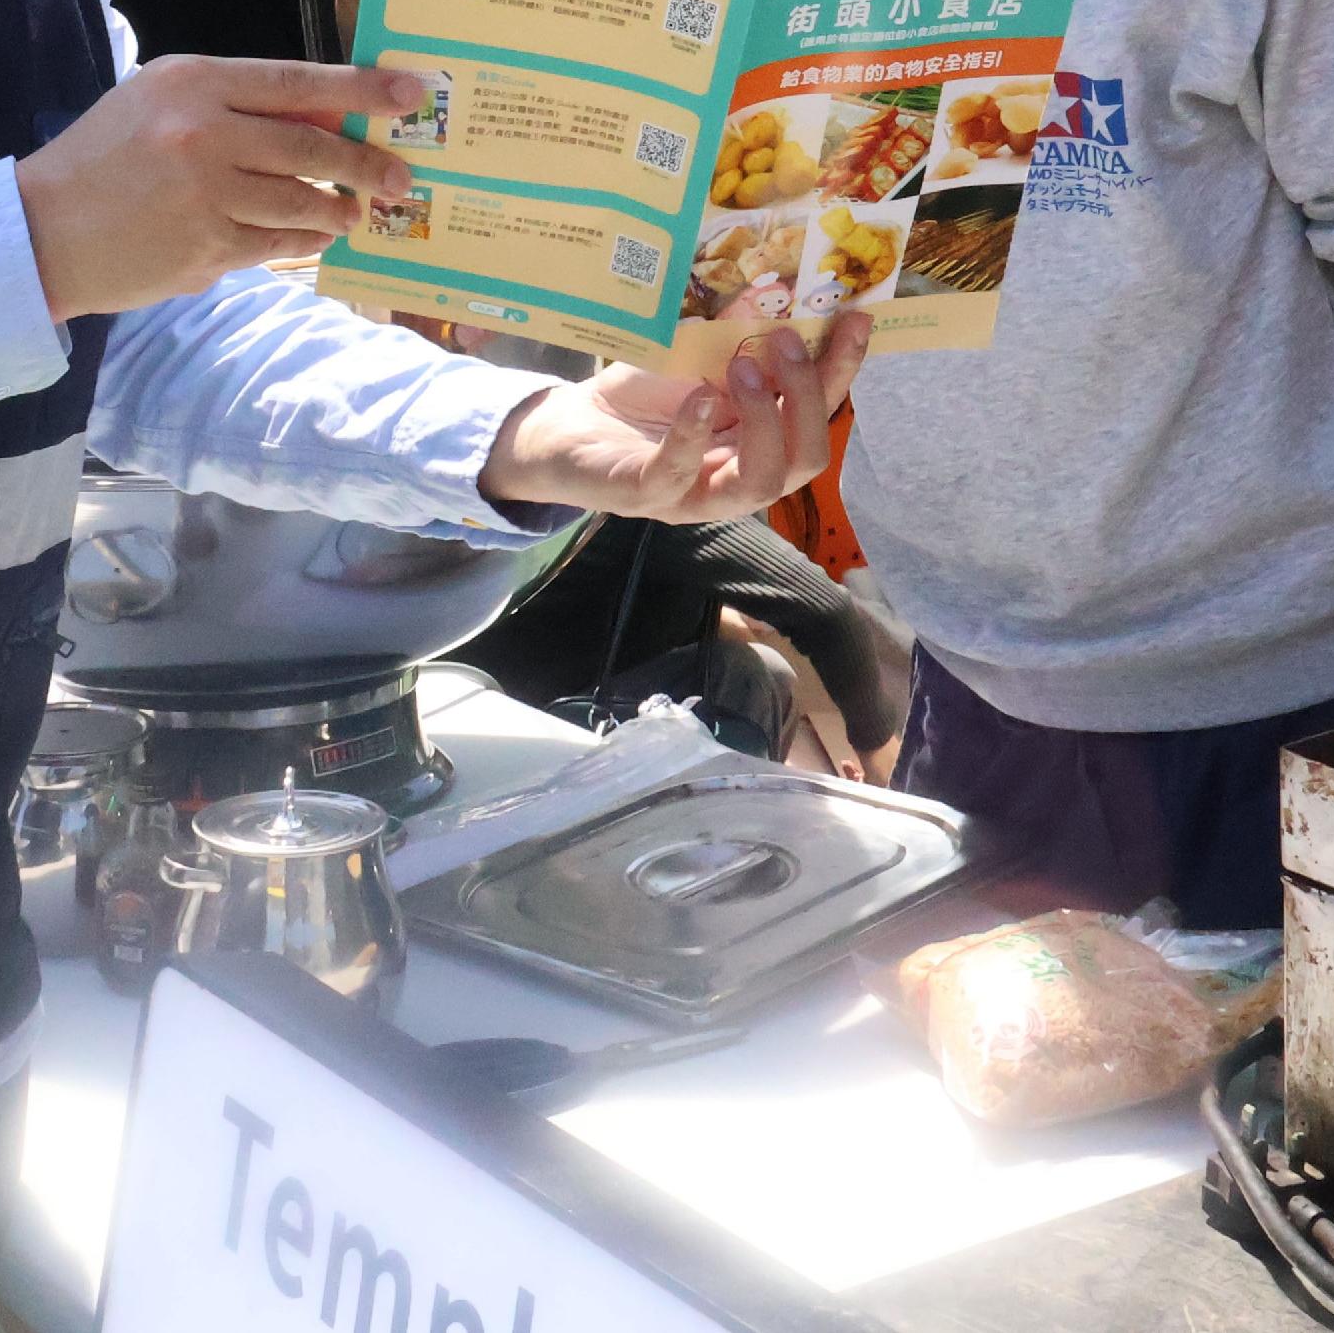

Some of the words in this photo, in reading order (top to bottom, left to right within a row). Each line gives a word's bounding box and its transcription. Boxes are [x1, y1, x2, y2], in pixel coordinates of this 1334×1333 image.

[779, 50, 1003, 89] 給食物業的食物安全指引
